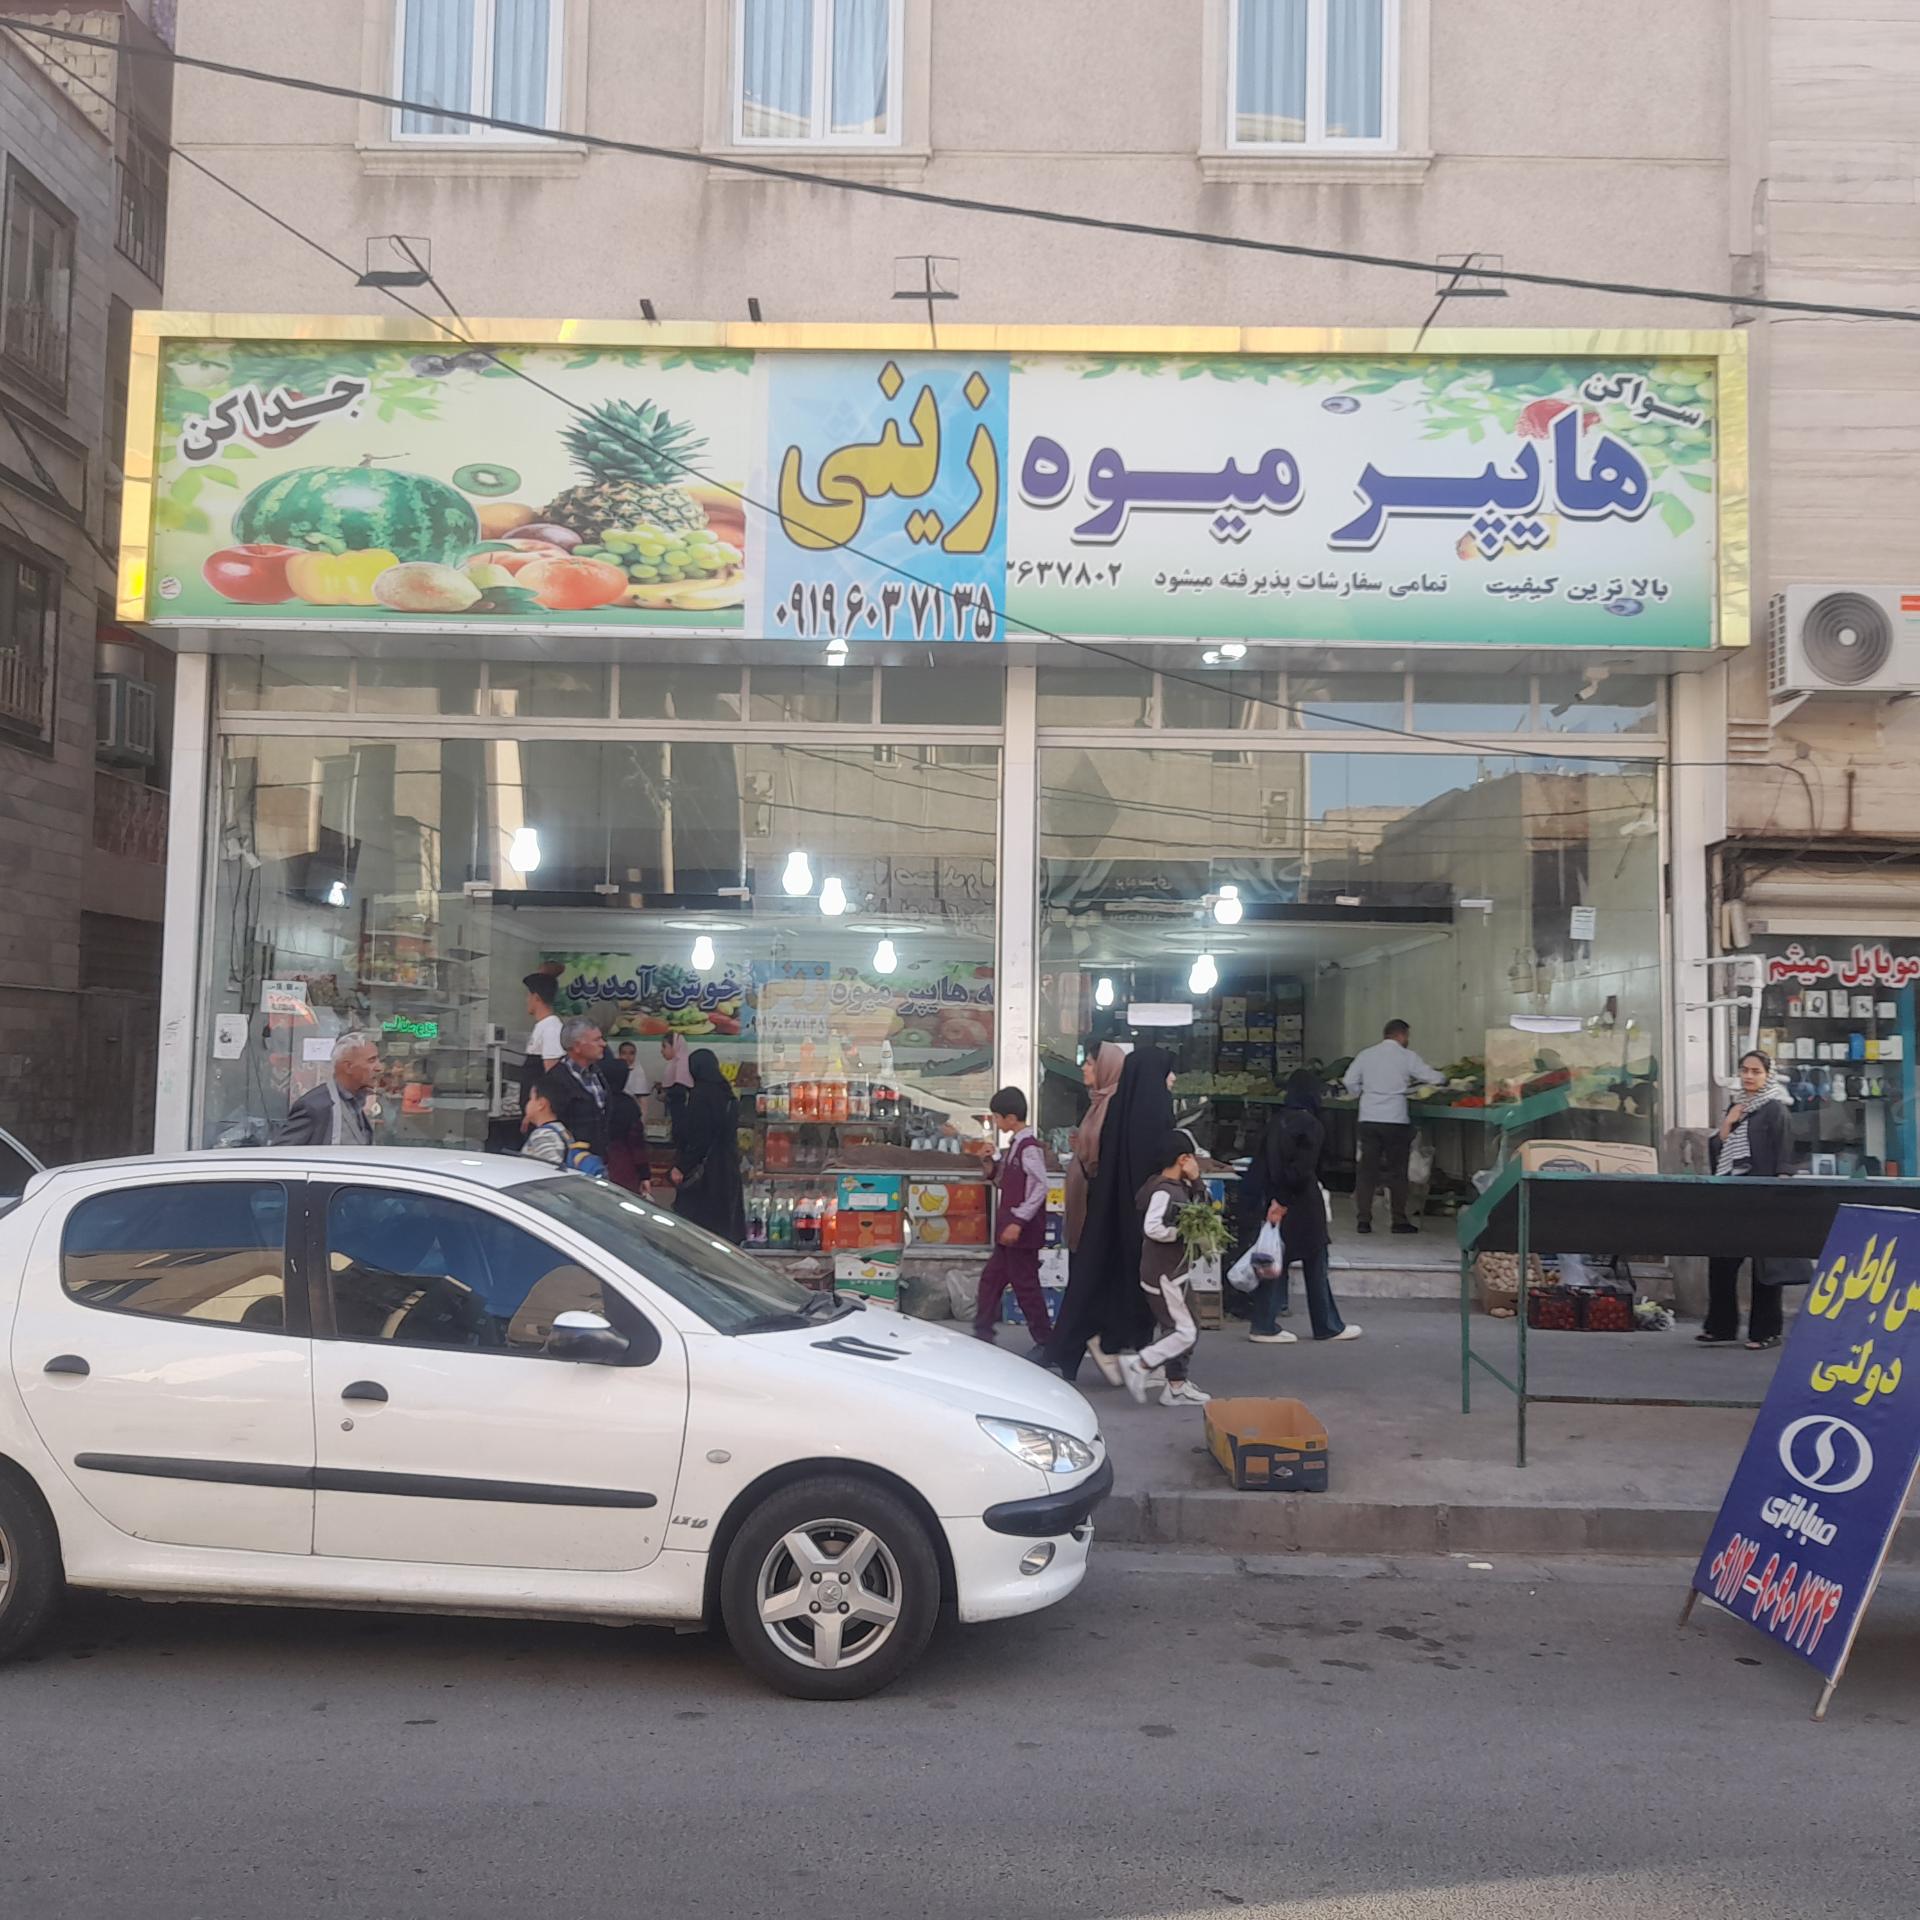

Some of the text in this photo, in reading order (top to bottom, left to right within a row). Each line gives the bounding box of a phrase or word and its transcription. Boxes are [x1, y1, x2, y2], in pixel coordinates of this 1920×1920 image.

[778, 360, 1000, 554] زینی
[1020, 408, 1650, 554] هایپر میوه
[1296, 570, 1383, 597] سفارشات
[1388, 572, 1449, 598] تمامی
[1485, 575, 1560, 601] کیفیت
[567, 964, 658, 1007] آمدید
[1767, 943, 1920, 988] موبایل میثم
[662, 968, 743, 1011] خوش
[897, 975, 970, 1017] هایپر
[1808, 1232, 1899, 1326] باطری
[1810, 1338, 1903, 1406] دولتی
